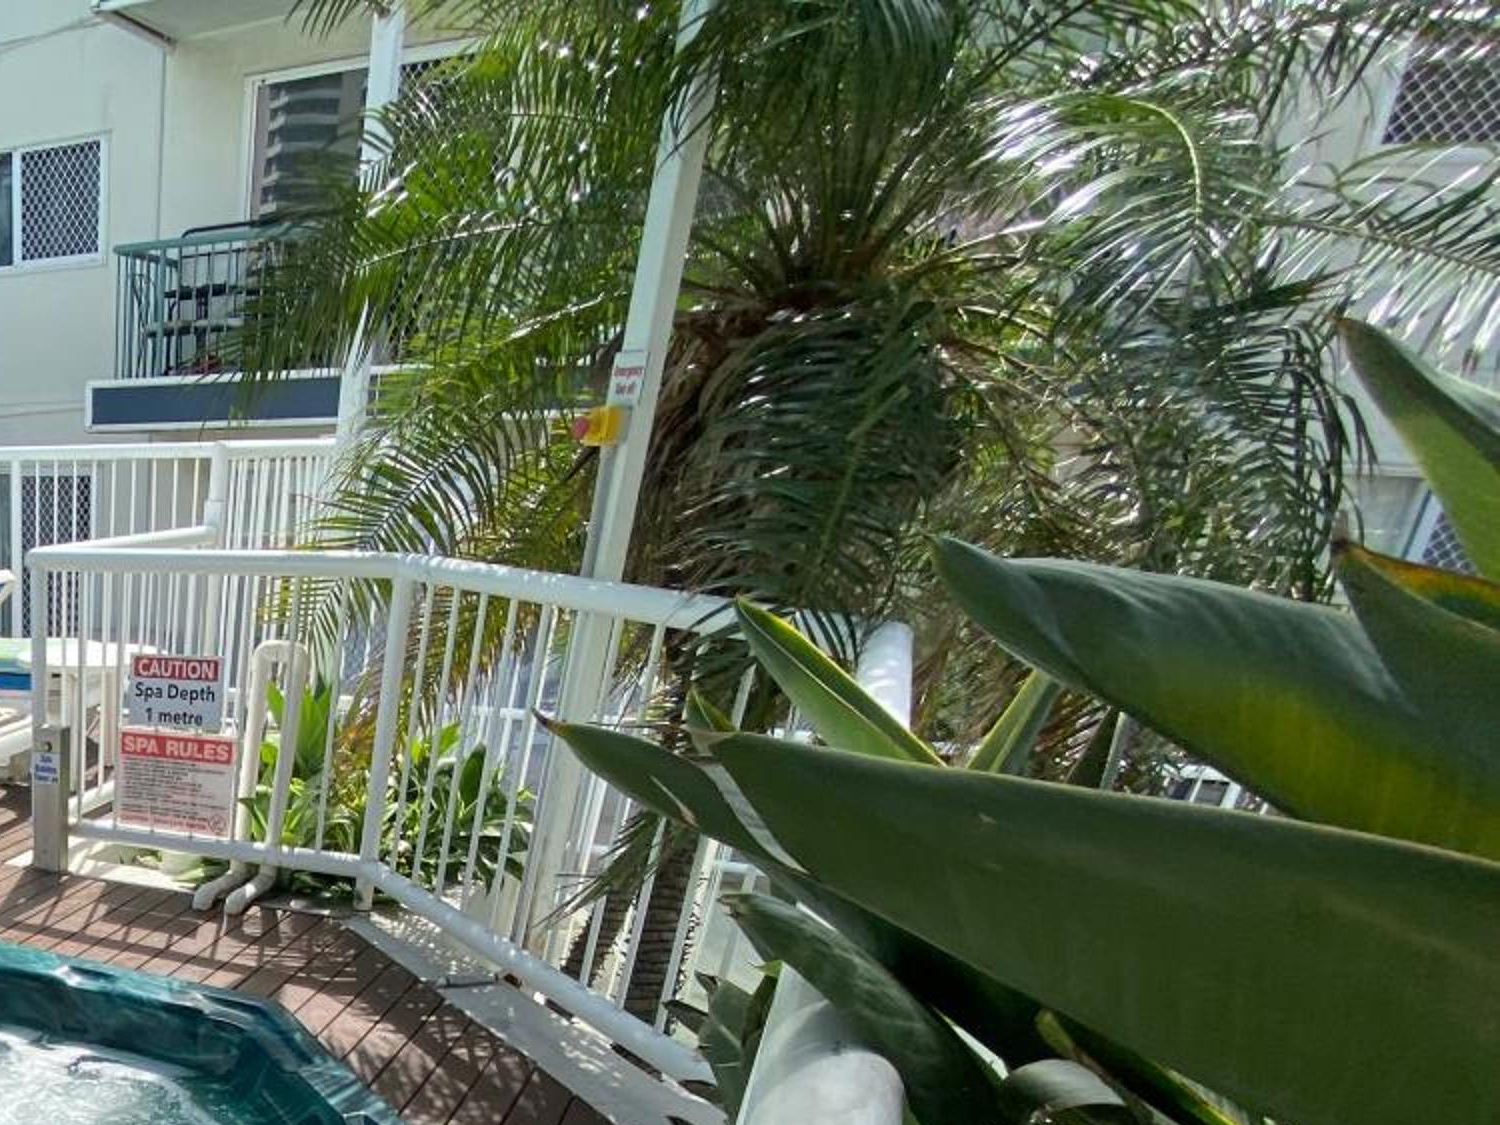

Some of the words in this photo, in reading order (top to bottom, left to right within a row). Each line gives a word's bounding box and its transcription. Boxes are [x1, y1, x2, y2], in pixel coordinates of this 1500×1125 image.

[138, 659, 216, 679] CAUTION
[135, 681, 163, 702] Spa
[167, 684, 215, 705] Depth
[145, 707, 152, 722] 1
[158, 710, 203, 726] metre
[123, 735, 159, 755] SPA
[165, 740, 229, 760] RULES
